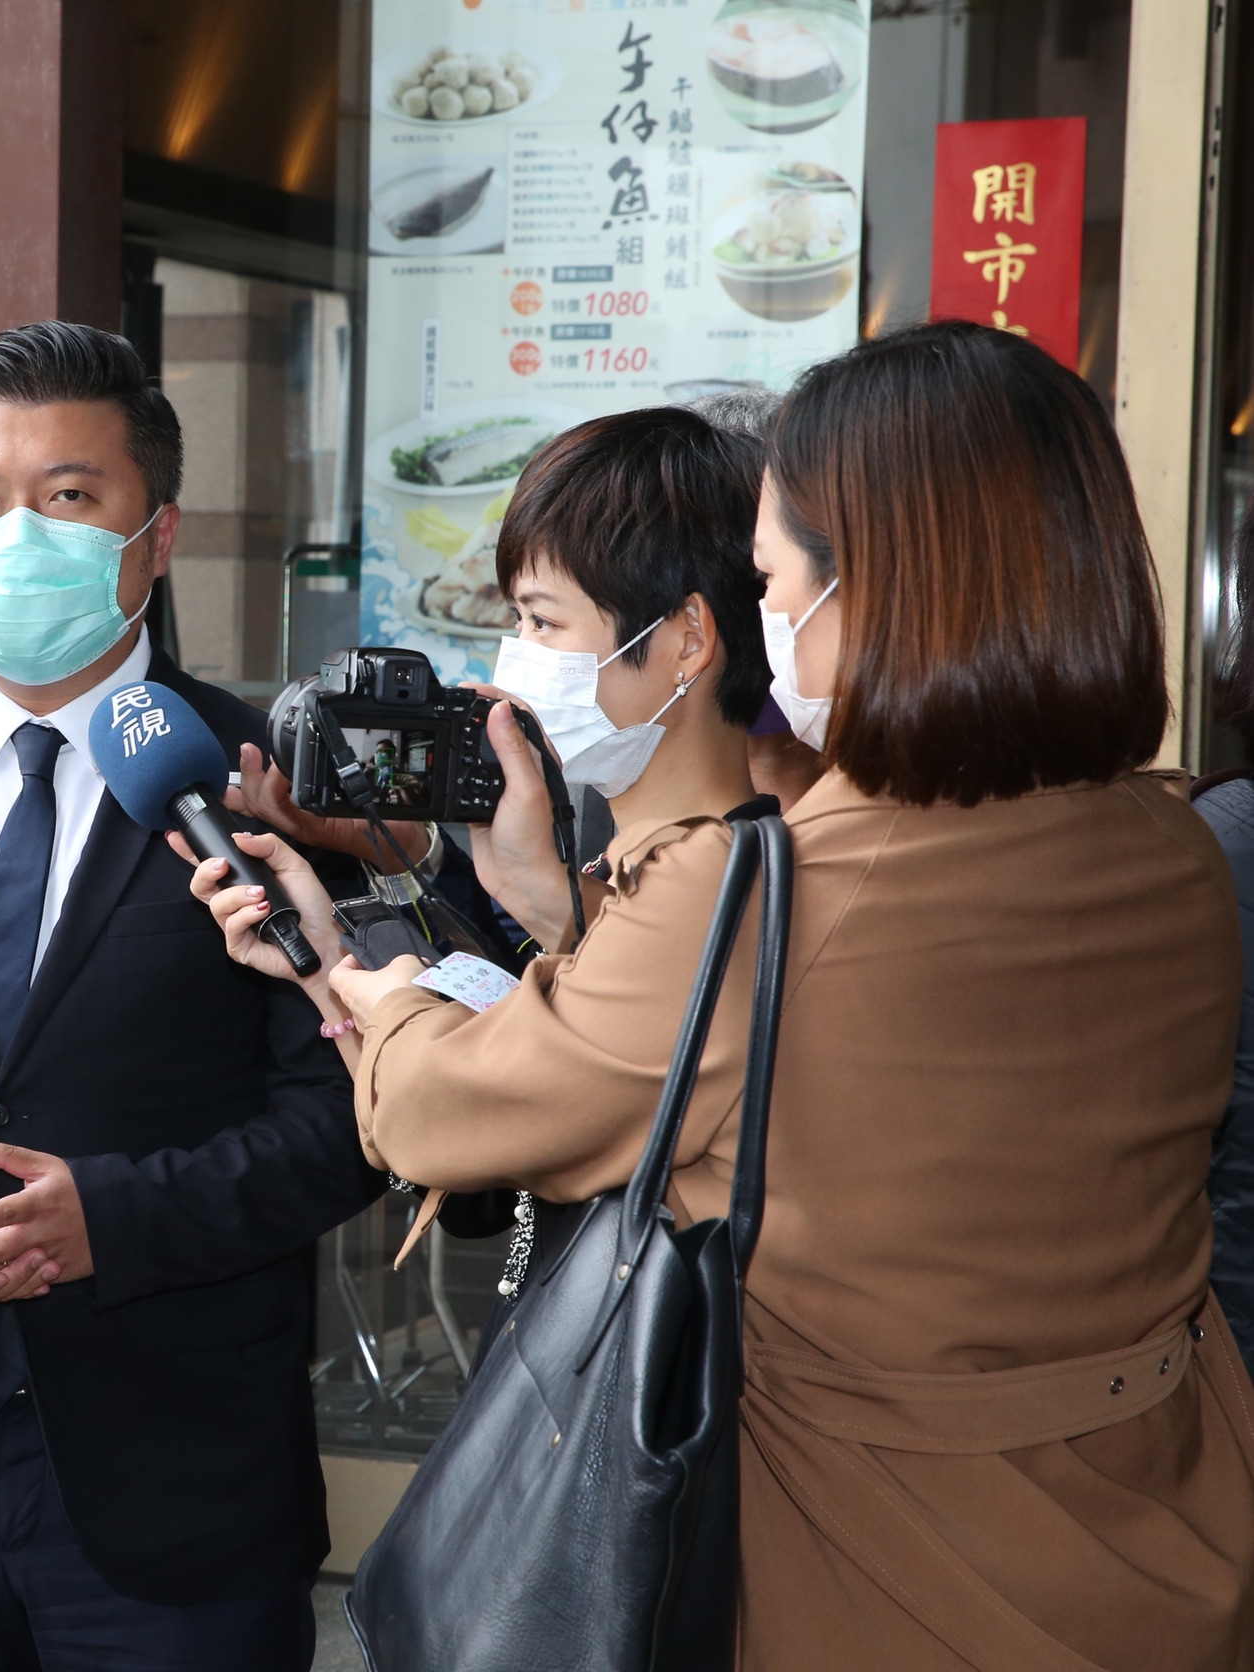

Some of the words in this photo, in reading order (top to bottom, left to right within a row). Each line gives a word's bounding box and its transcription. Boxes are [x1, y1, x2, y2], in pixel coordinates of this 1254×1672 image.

[585, 290, 649, 317] 1080
[584, 347, 648, 372] 1160
[111, 685, 171, 758] 民視
